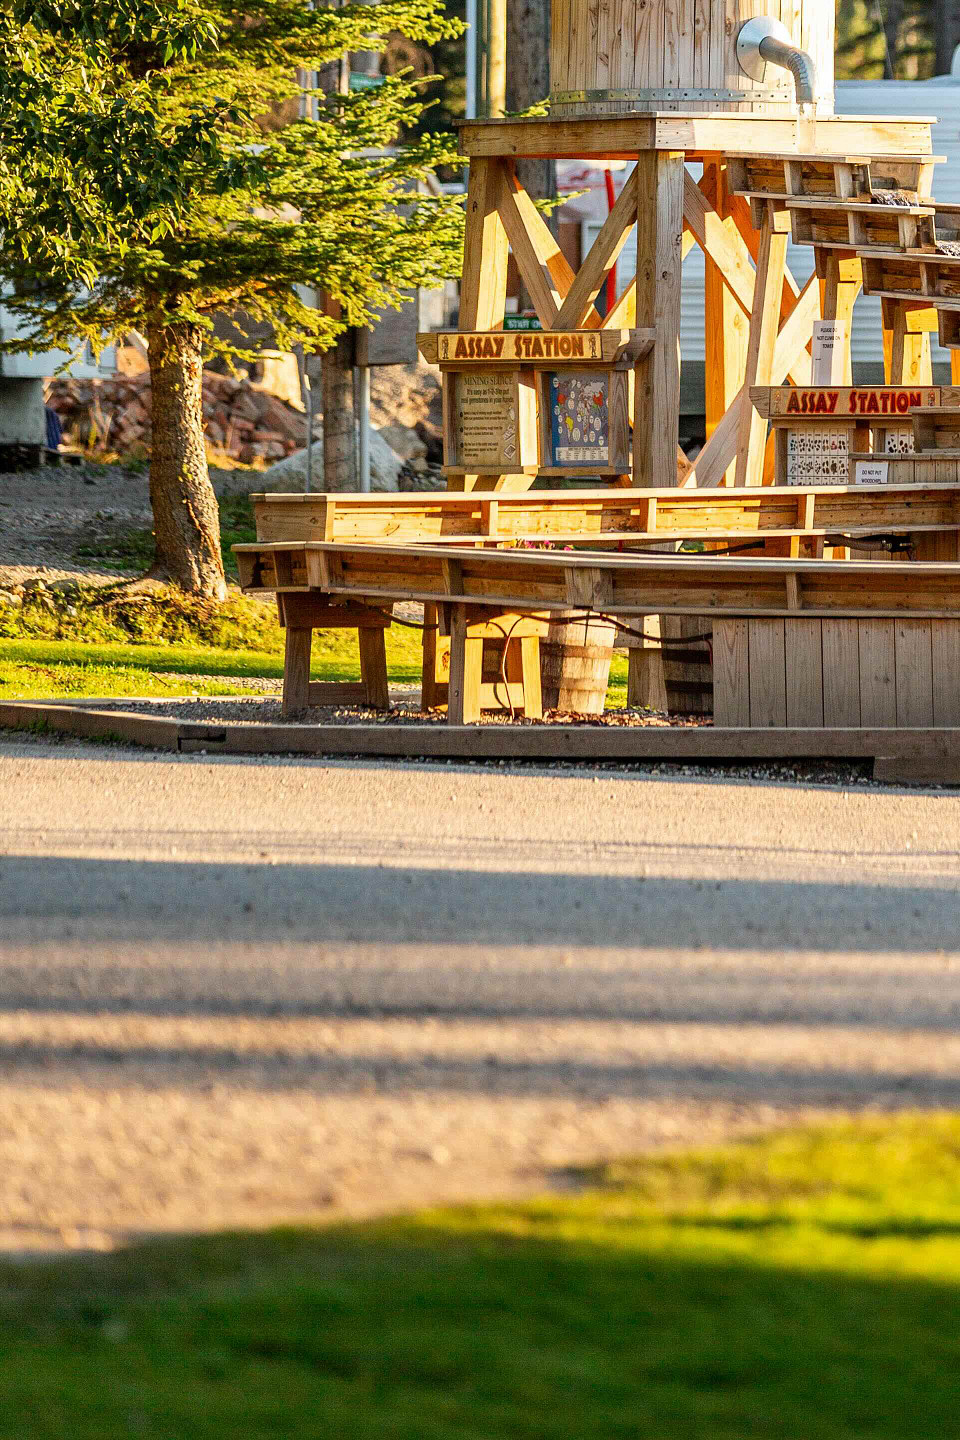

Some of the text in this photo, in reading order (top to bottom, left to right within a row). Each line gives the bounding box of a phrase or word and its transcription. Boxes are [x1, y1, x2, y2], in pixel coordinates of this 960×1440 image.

[454, 334, 585, 359] ASSAY STATION
[787, 389, 922, 414] ASSAY STATION
